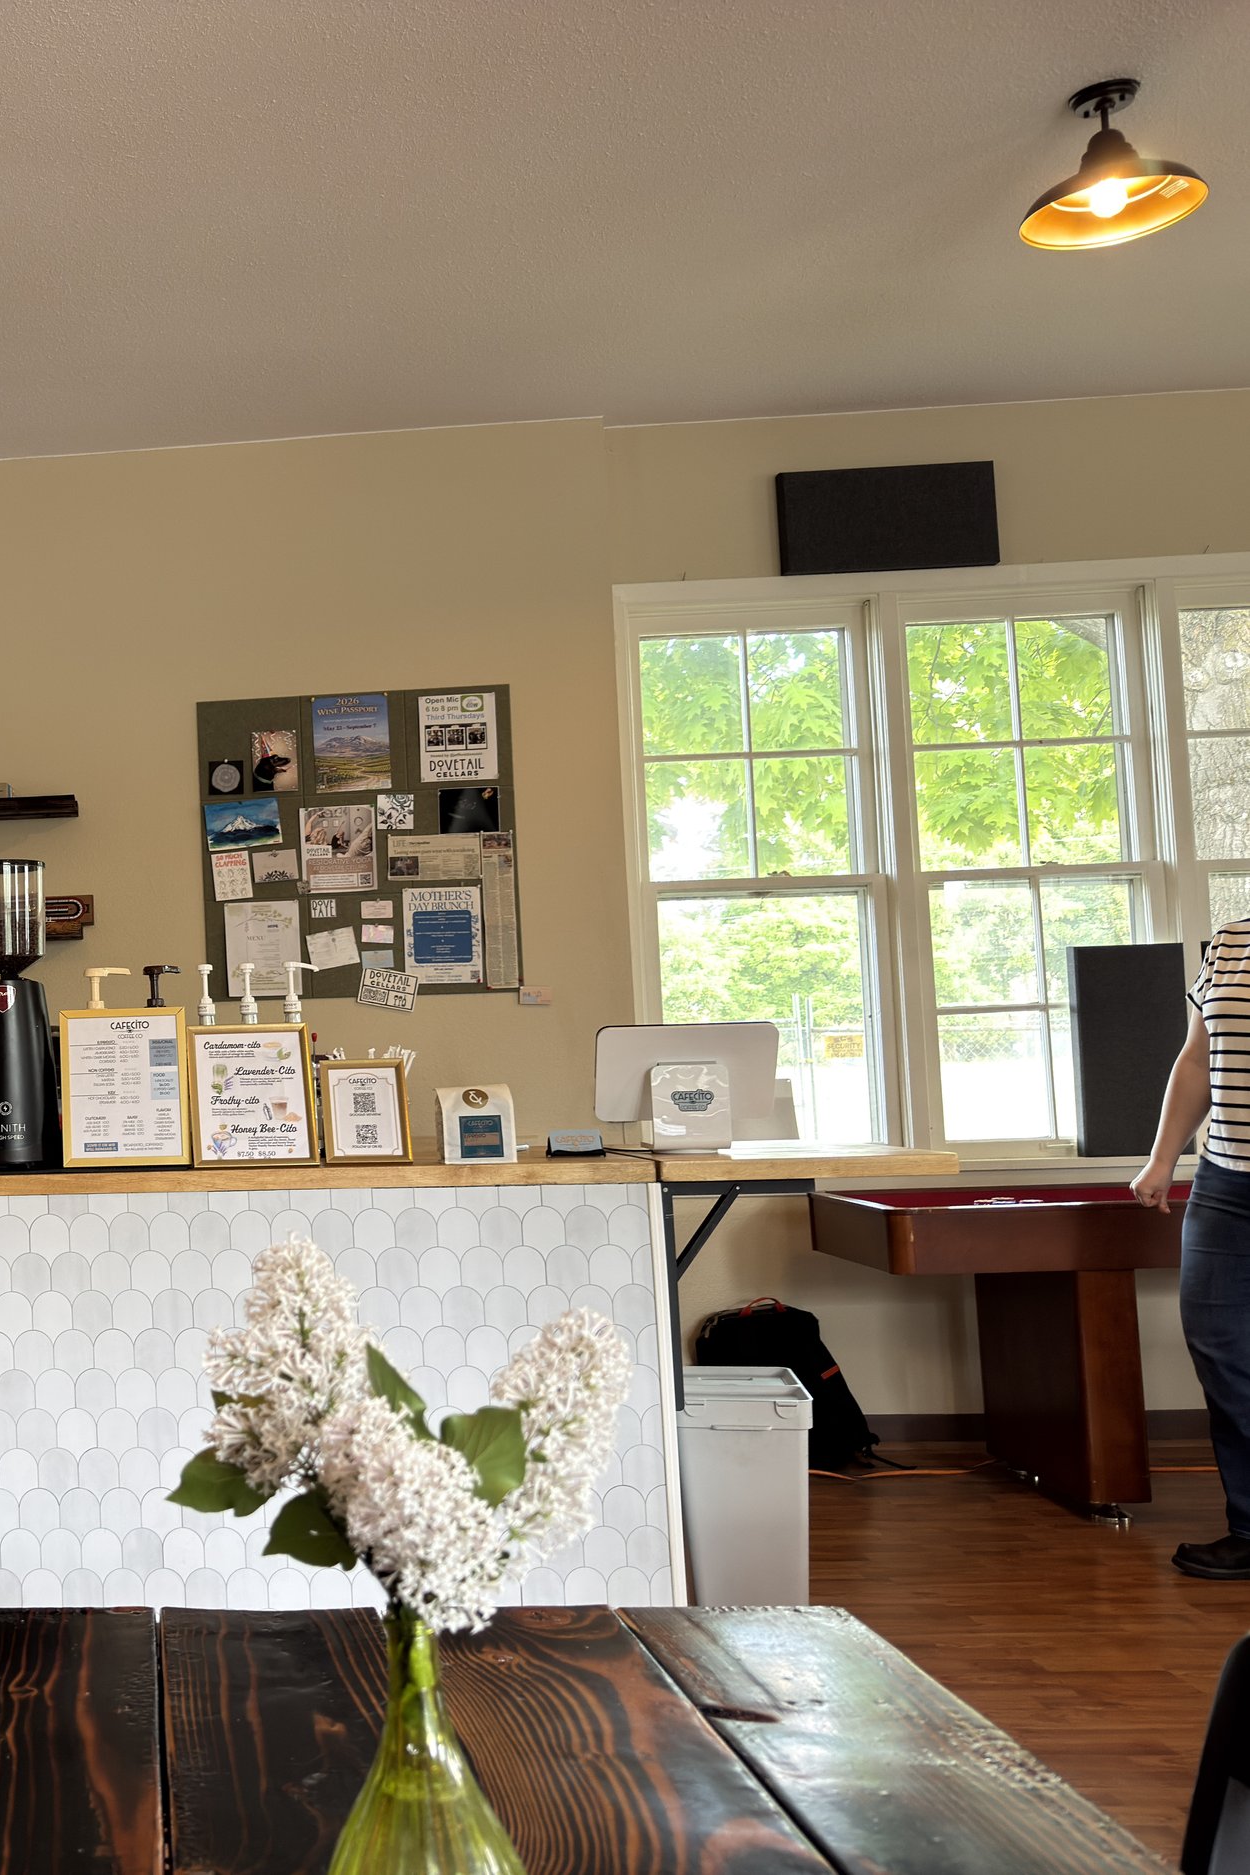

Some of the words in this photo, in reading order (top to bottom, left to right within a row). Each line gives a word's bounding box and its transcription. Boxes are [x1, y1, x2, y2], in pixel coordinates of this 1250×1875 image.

[336, 697, 359, 706] 2026
[425, 697, 444, 705] Open
[317, 707, 339, 717] WINE
[341, 706, 378, 715] PASSPORT
[447, 712, 485, 720] Thursdays
[430, 758, 485, 772] DOVETAIL
[436, 770, 479, 778] CELLARS
[215, 859, 247, 868] CLAPPING
[410, 889, 471, 902] MOTHER'S
[408, 902, 430, 911] DAY
[431, 900, 474, 911] BRUNCH
[369, 970, 411, 987] DOVETAIL
[370, 980, 407, 991] CELLARS
[203, 1041, 261, 1050] Cardamom-cito
[234, 1066, 296, 1076] Lavender-Cito
[210, 1095, 260, 1107] Frothy-cito
[673, 1091, 712, 1101] CAFECITO
[230, 1124, 258, 1136] Honey
[259, 1123, 298, 1133] Bee-Cito
